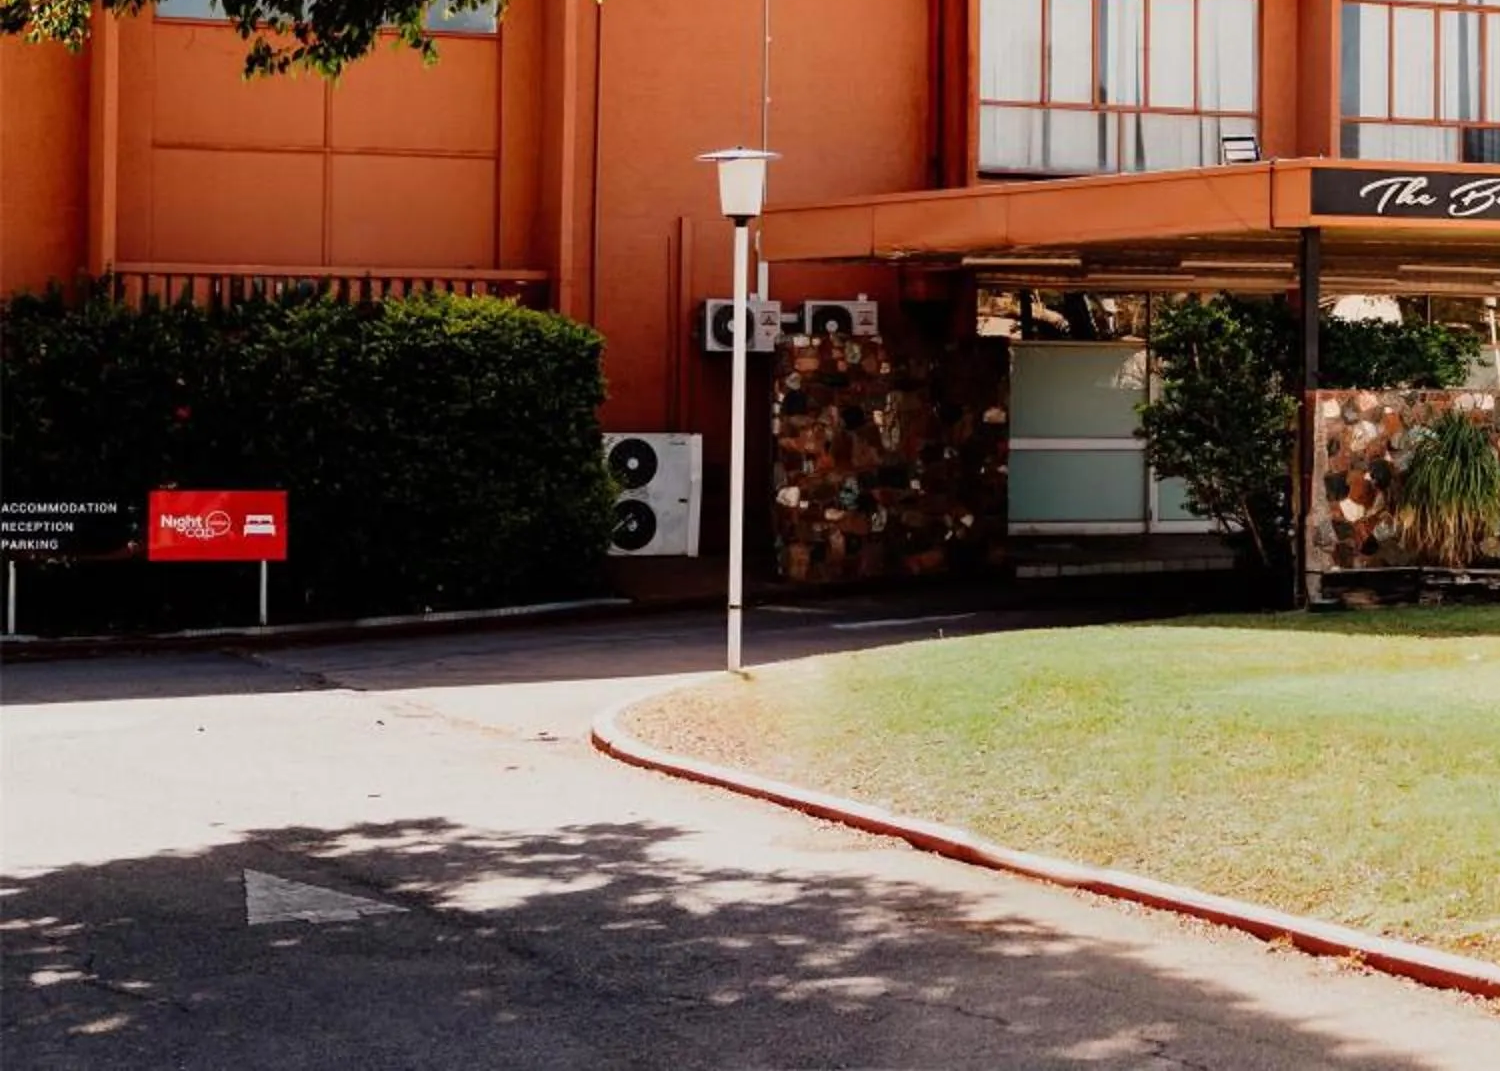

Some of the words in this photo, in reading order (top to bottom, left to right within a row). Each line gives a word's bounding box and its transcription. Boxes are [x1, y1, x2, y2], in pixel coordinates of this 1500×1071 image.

[1359, 176, 1437, 214] The
[1, 502, 118, 514] ACCOMMODATION
[1, 520, 74, 532] RECEPTION
[161, 514, 203, 532] Night
[185, 528, 215, 541] cap
[1, 539, 59, 550] PARKING
